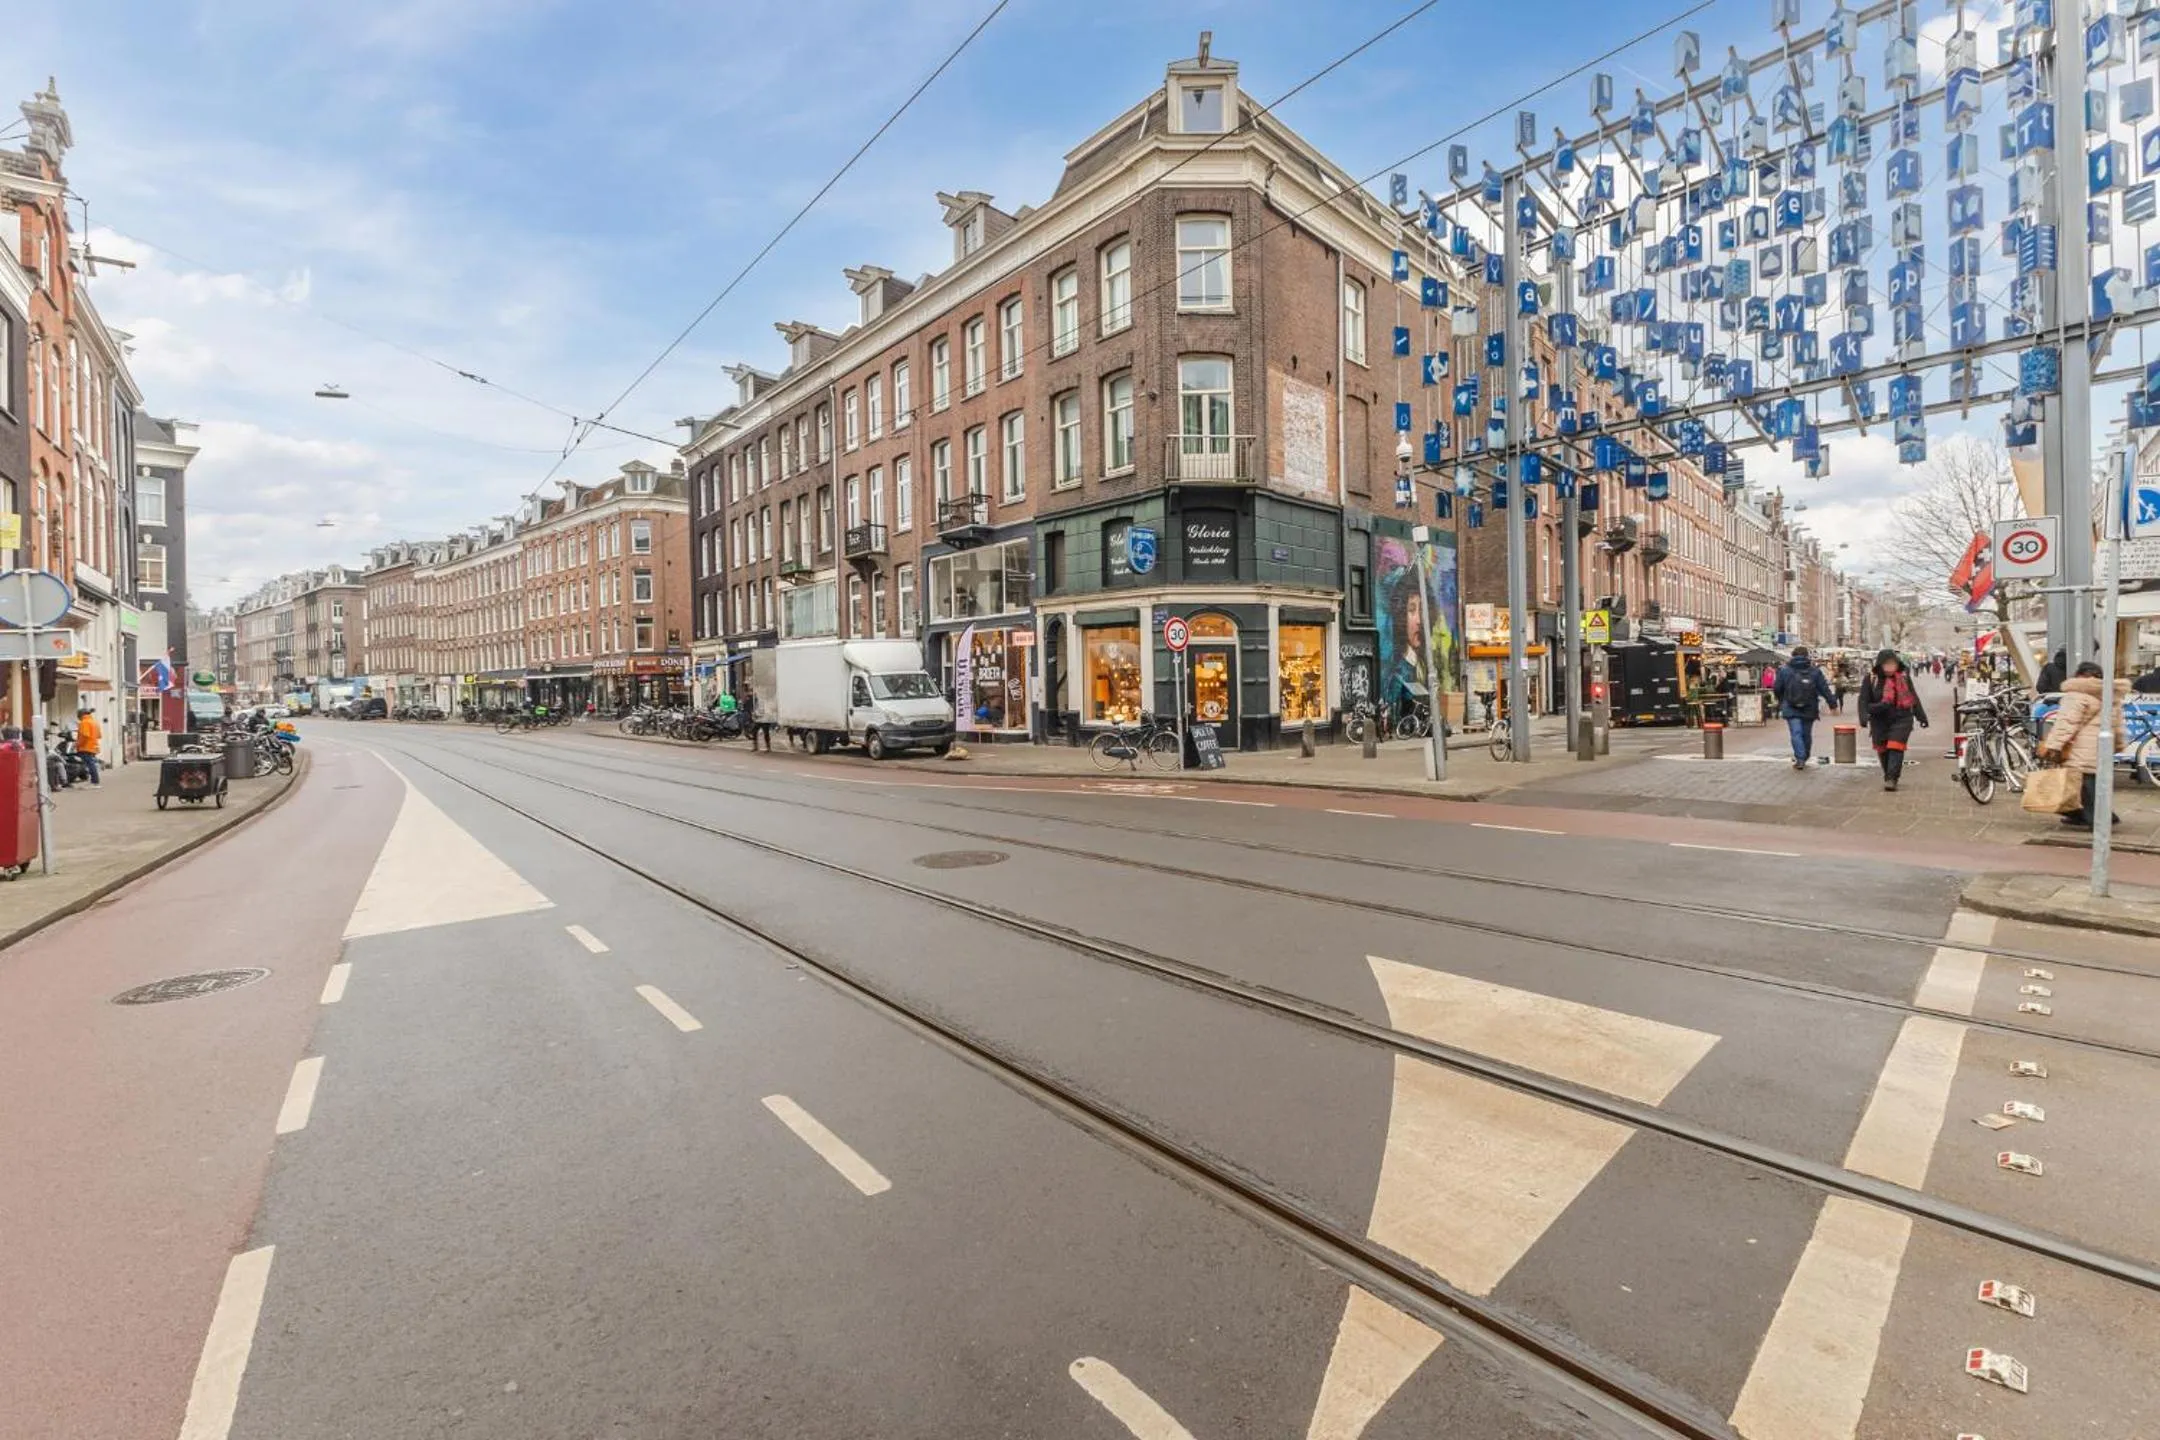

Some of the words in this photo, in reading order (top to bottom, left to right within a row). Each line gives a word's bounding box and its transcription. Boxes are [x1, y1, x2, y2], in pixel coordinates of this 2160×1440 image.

[2020, 120, 2033, 145] T
[1890, 166, 1899, 191] R
[1788, 197, 1800, 213] e
[1689, 228, 1699, 245] b
[1905, 269, 1917, 292] p
[1525, 287, 1535, 302] a
[1952, 317, 1966, 341] T
[1645, 387, 1656, 402] a
[1561, 406, 1577, 421] m
[1187, 524, 1231, 539] Gloria
[2012, 541, 2039, 554] 30
[1170, 629, 1185, 640] 30
